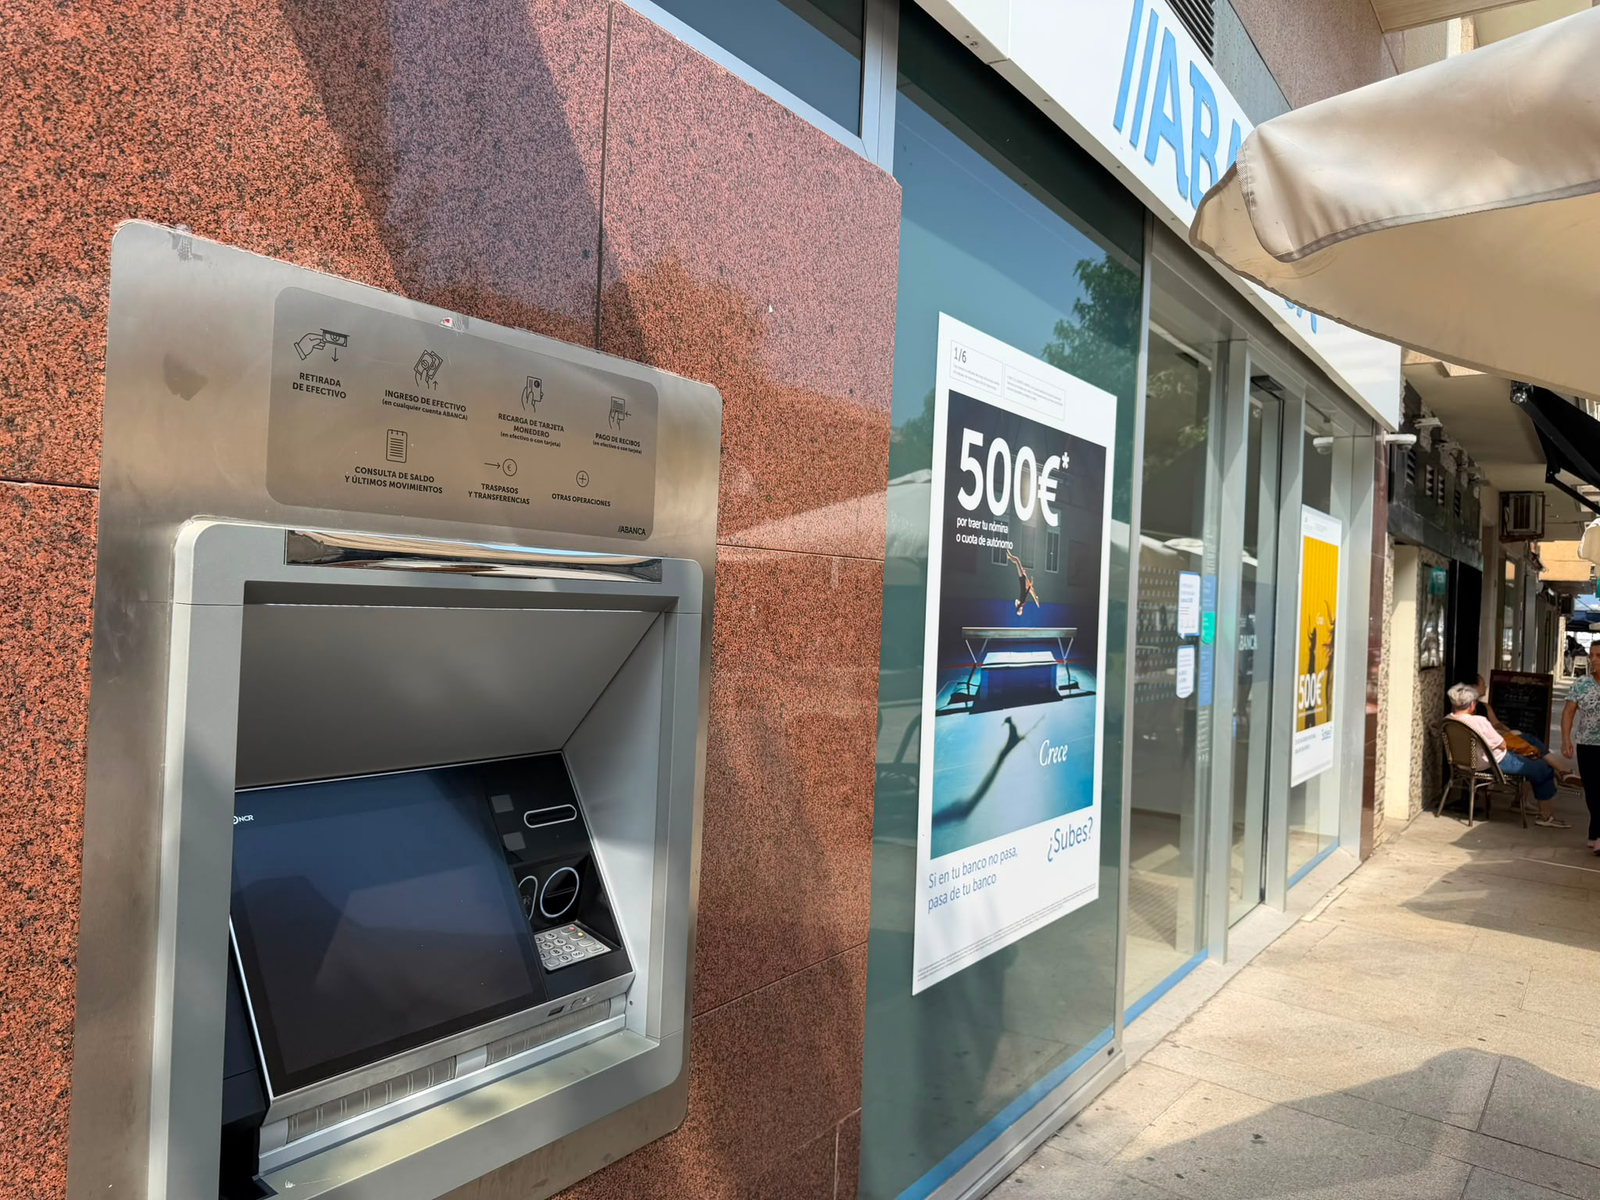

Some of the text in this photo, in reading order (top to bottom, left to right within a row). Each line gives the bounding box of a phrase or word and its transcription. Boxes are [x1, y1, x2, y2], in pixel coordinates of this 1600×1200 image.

[954, 347, 967, 363] 1/6
[299, 372, 341, 387] RETIRADA
[292, 382, 347, 399] DE EFECTIVO
[385, 390, 466, 412] INGRESO DE EFECTIVO
[393, 401, 421, 412] cualquier
[422, 407, 441, 416] cuenta
[443, 410, 468, 421] ABANCA)
[498, 413, 528, 425] RECARGA
[539, 421, 564, 432] TARJETA
[509, 433, 529, 442] efectivo
[544, 440, 561, 448] tarjeta)
[513, 426, 550, 438] MONEDERO
[595, 433, 610, 442] PAGO
[619, 438, 640, 447] RECIBOS
[600, 441, 616, 449] efectivo
[355, 466, 435, 483] CONSULTA DE SALDO
[352, 475, 387, 487] ÚLTIMOS
[389, 481, 443, 494] MOVIMIENTOS
[481, 483, 519, 494] TRASPASOS
[474, 492, 530, 505] TRANSFERENCIAS
[552, 493, 611, 507] OTRAS OPERACIONES
[956, 516, 1008, 534] por traer tu nómina
[956, 534, 1013, 550] o cuota de autónomo
[1039, 739, 1068, 767] Crece
[1047, 816, 1093, 863] ¿Subes?
[929, 845, 1018, 889] Si en tu banco no pasa,
[928, 873, 996, 914] pasa de tu banco
